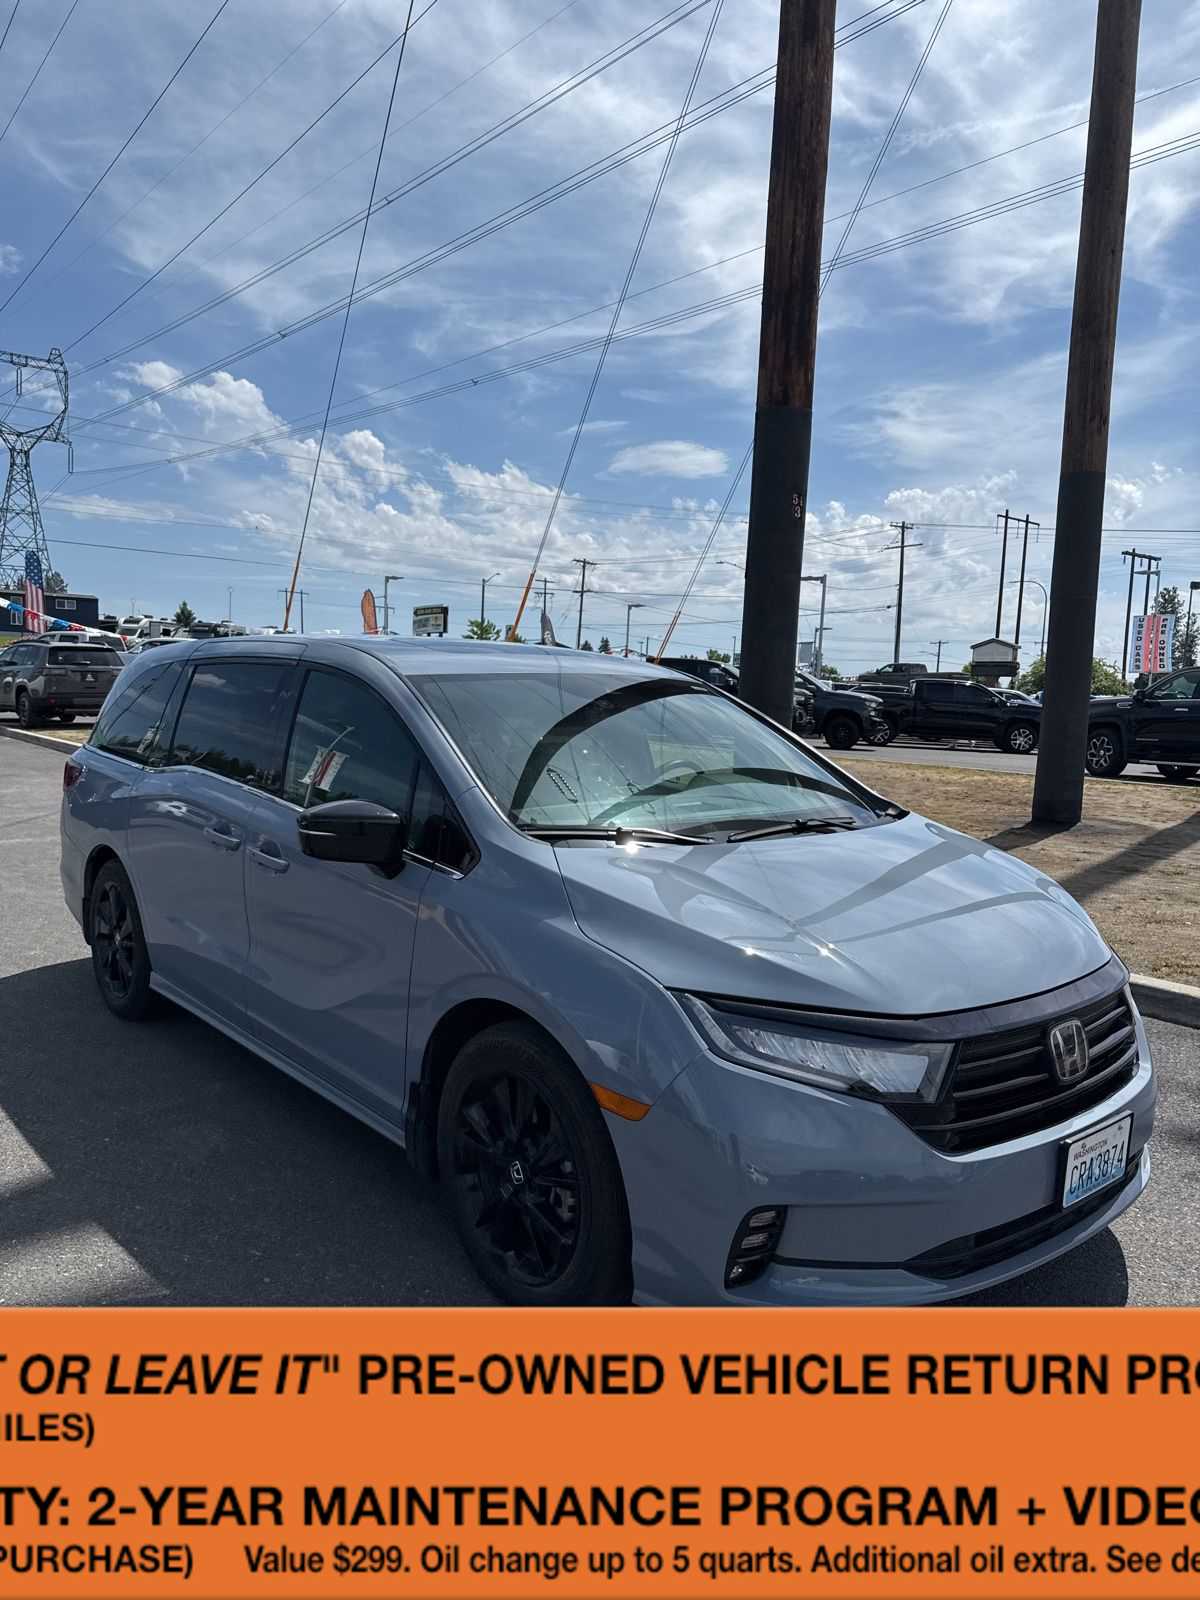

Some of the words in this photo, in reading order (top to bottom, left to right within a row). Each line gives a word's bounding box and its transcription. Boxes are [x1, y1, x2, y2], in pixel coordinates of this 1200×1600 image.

[1136, 617, 1145, 642] USED
[1158, 639, 1166, 669] OWNED
[1073, 1139, 1108, 1161] WASHINGTON
[1069, 1140, 1125, 1194] CRA3874
